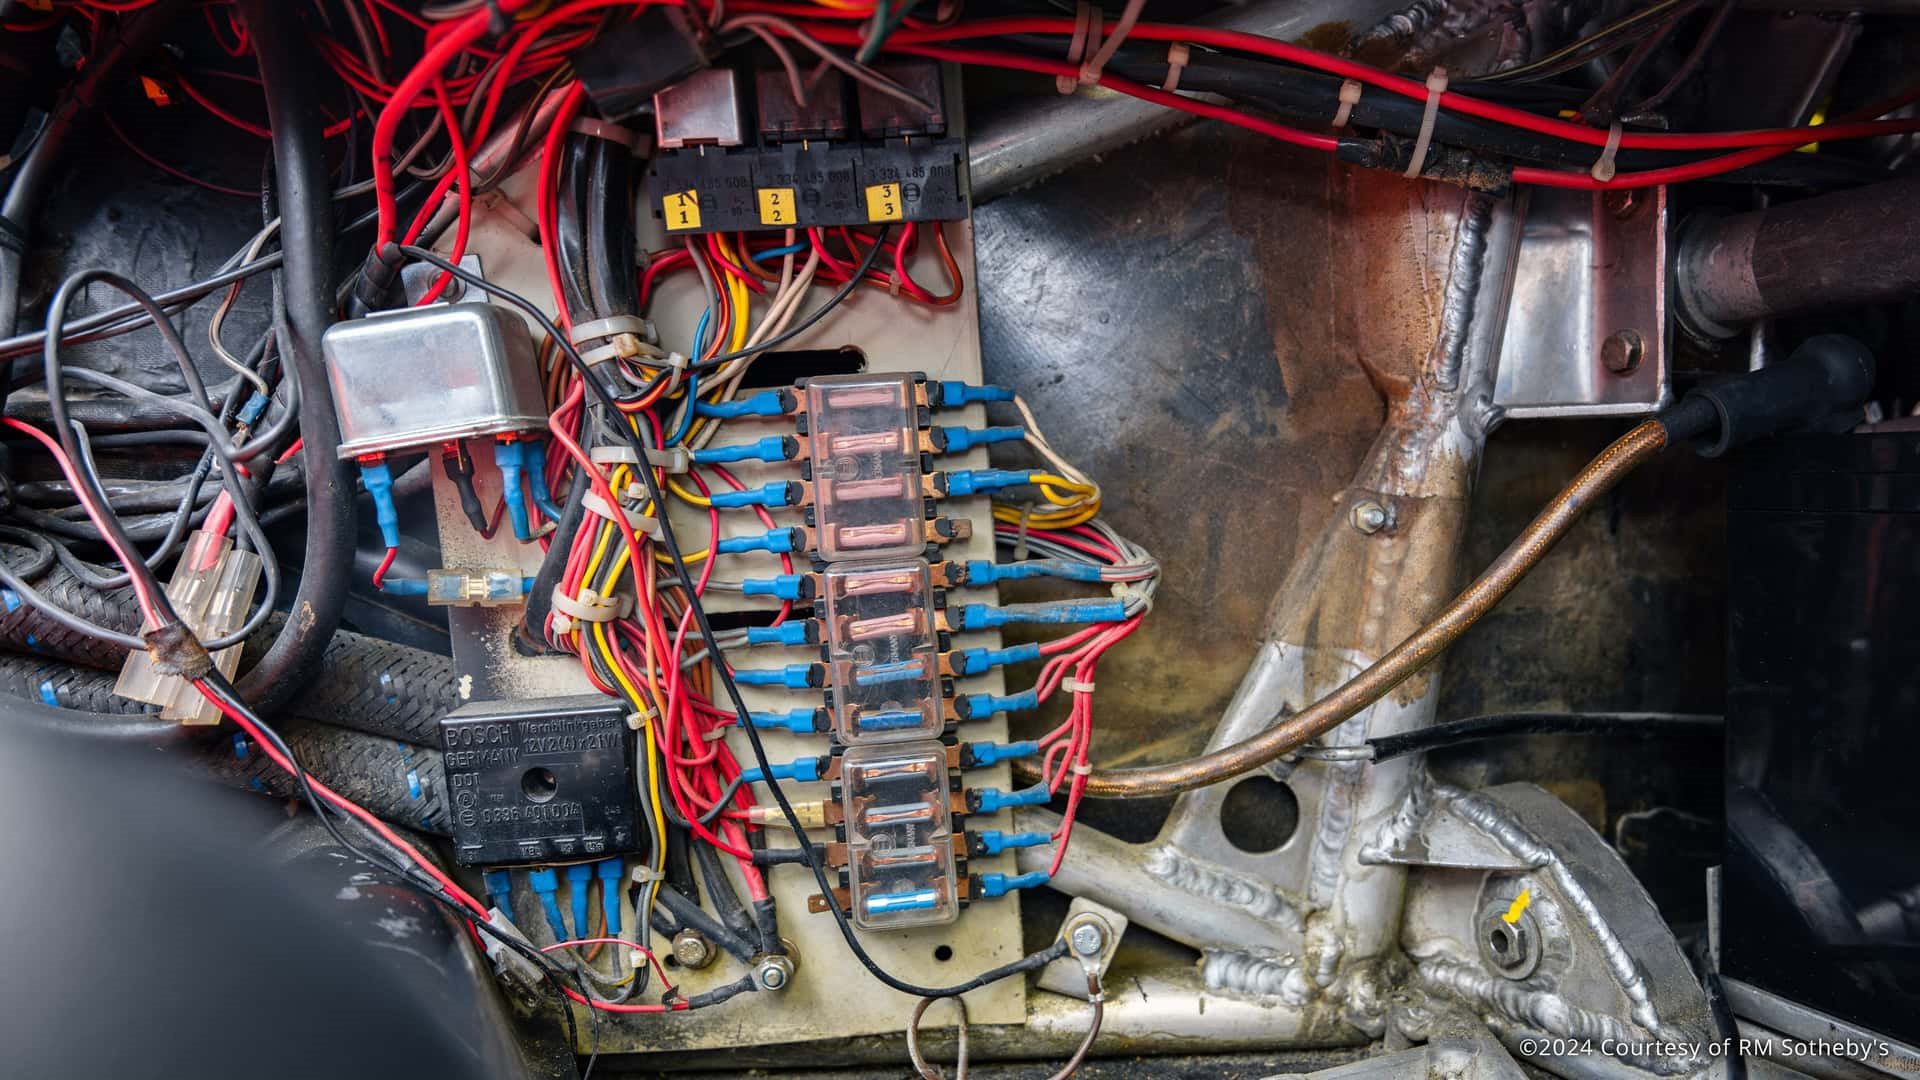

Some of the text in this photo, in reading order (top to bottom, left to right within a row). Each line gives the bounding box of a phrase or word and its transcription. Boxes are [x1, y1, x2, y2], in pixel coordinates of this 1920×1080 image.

[678, 192, 688, 206] 1
[883, 185, 892, 199] 3
[771, 193, 780, 206] 2
[772, 209, 783, 222] 2
[885, 202, 894, 216] 3
[680, 212, 689, 225] 1
[445, 724, 513, 747] BOSCH
[445, 747, 520, 768] GERMANY
